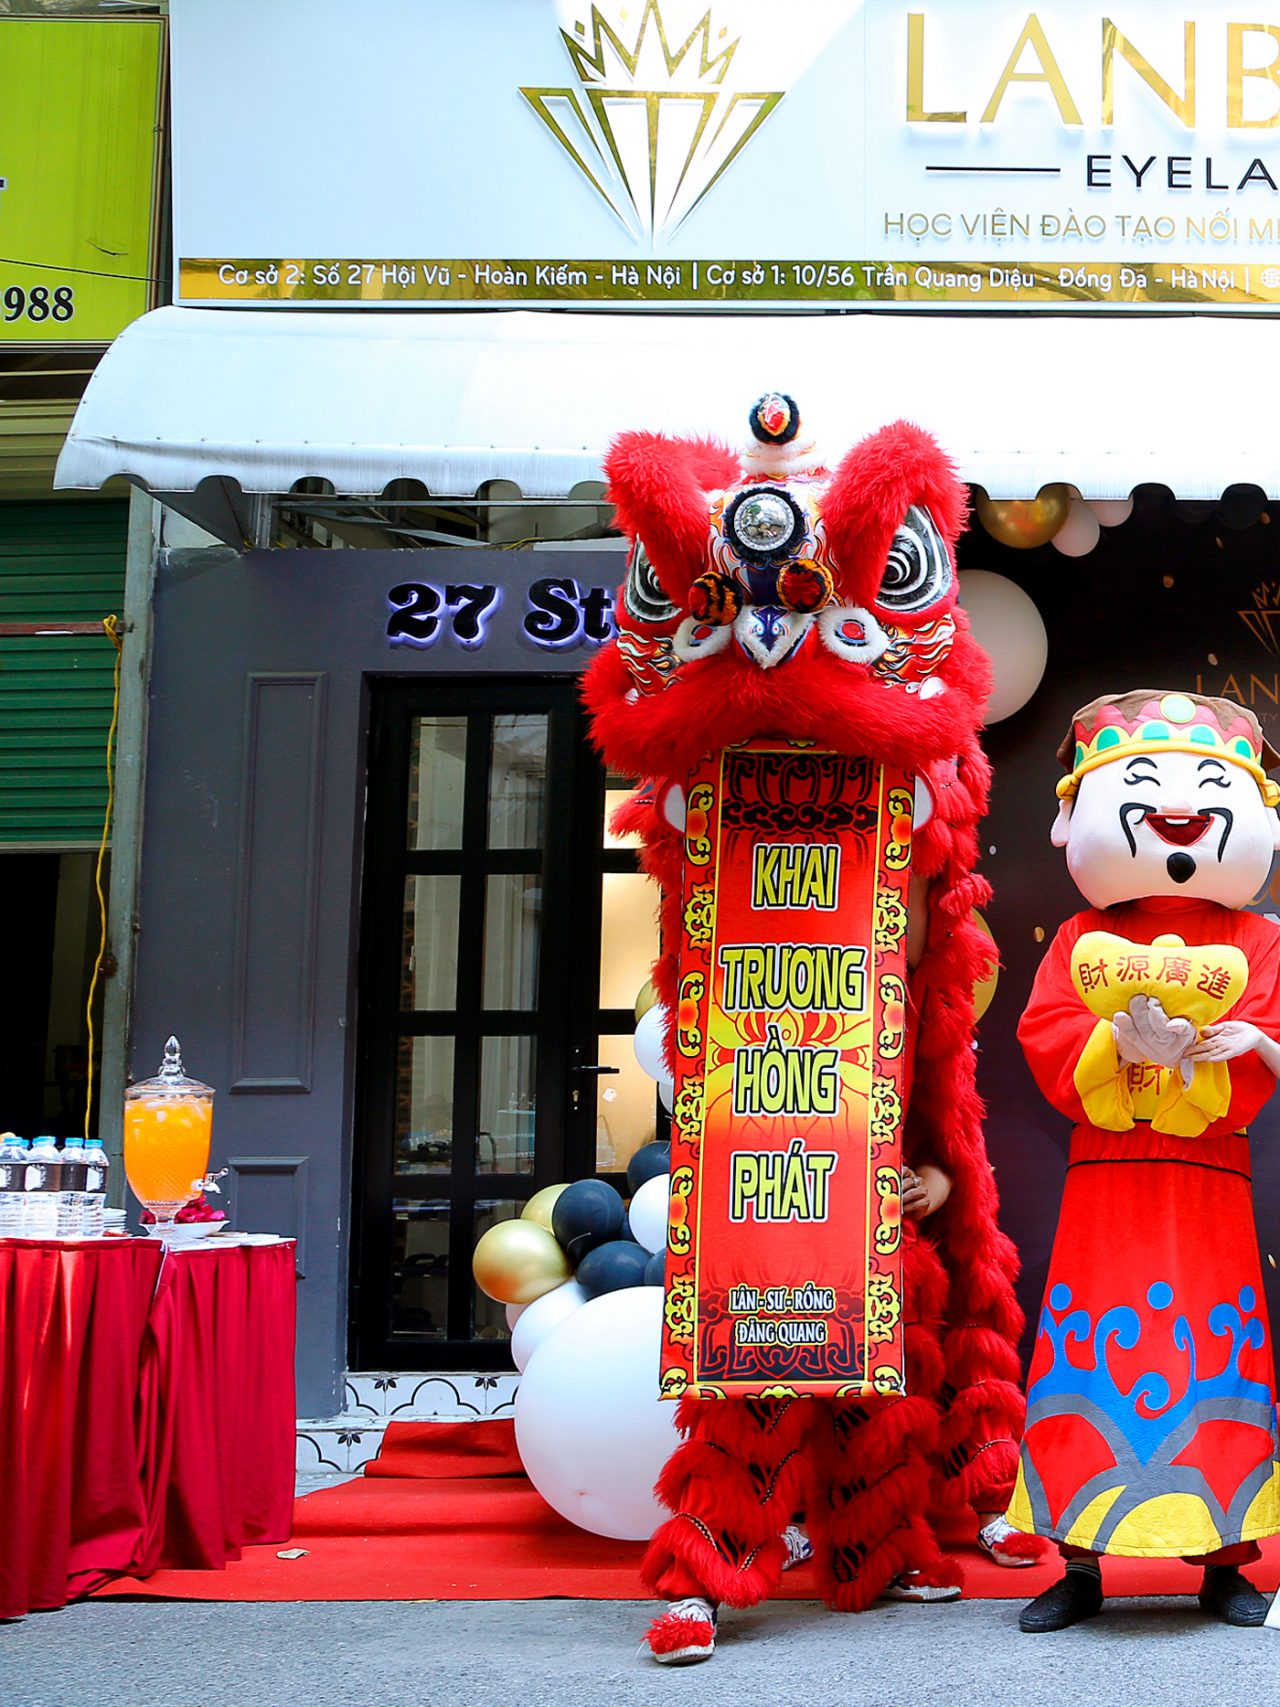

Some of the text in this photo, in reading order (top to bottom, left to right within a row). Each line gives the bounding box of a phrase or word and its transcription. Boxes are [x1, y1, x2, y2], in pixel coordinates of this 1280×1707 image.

[884, 212, 952, 241] HỌC
[960, 207, 1030, 241] VIỆN
[1040, 207, 1106, 238] ĐÀO
[1115, 213, 1176, 242] TẠO
[1186, 207, 1238, 241] NỐI
[1249, 217, 1280, 240] MI
[218, 265, 249, 286] Cơ
[255, 263, 279, 286] sở
[285, 266, 305, 286] 2:
[312, 262, 340, 286] Số
[347, 265, 375, 286] 27
[382, 265, 416, 290] Hội
[423, 264, 451, 286] Vũ
[474, 265, 528, 286] Hoàn
[536, 263, 588, 287] Kiếm
[612, 265, 640, 286] Hà
[646, 265, 681, 291] Nội
[706, 265, 735, 286] Cơ
[742, 263, 765, 285] sở
[771, 265, 786, 286] 1:
[792, 265, 855, 290] 10/56
[862, 265, 908, 287] Trần
[914, 266, 981, 293] Quang
[989, 266, 1035, 291] Diệu
[1058, 266, 1112, 293] Đống
[1119, 268, 1147, 289] Đa
[1171, 268, 1199, 289] Hà
[1202, 268, 1236, 293] Nội
[386, 577, 620, 643] 27 St
[752, 843, 840, 910] KHAI
[719, 944, 868, 1012] TRƯƠNG
[1078, 955, 1231, 1000] 財源廣進
[733, 1024, 840, 1116] HỒNG
[730, 1138, 838, 1222] PHÁT
[729, 1286, 757, 1311] LÂN
[766, 1288, 788, 1311] SƯ
[794, 1284, 834, 1311] RỒNG
[737, 1320, 826, 1346] ĐĂNG QUANG
